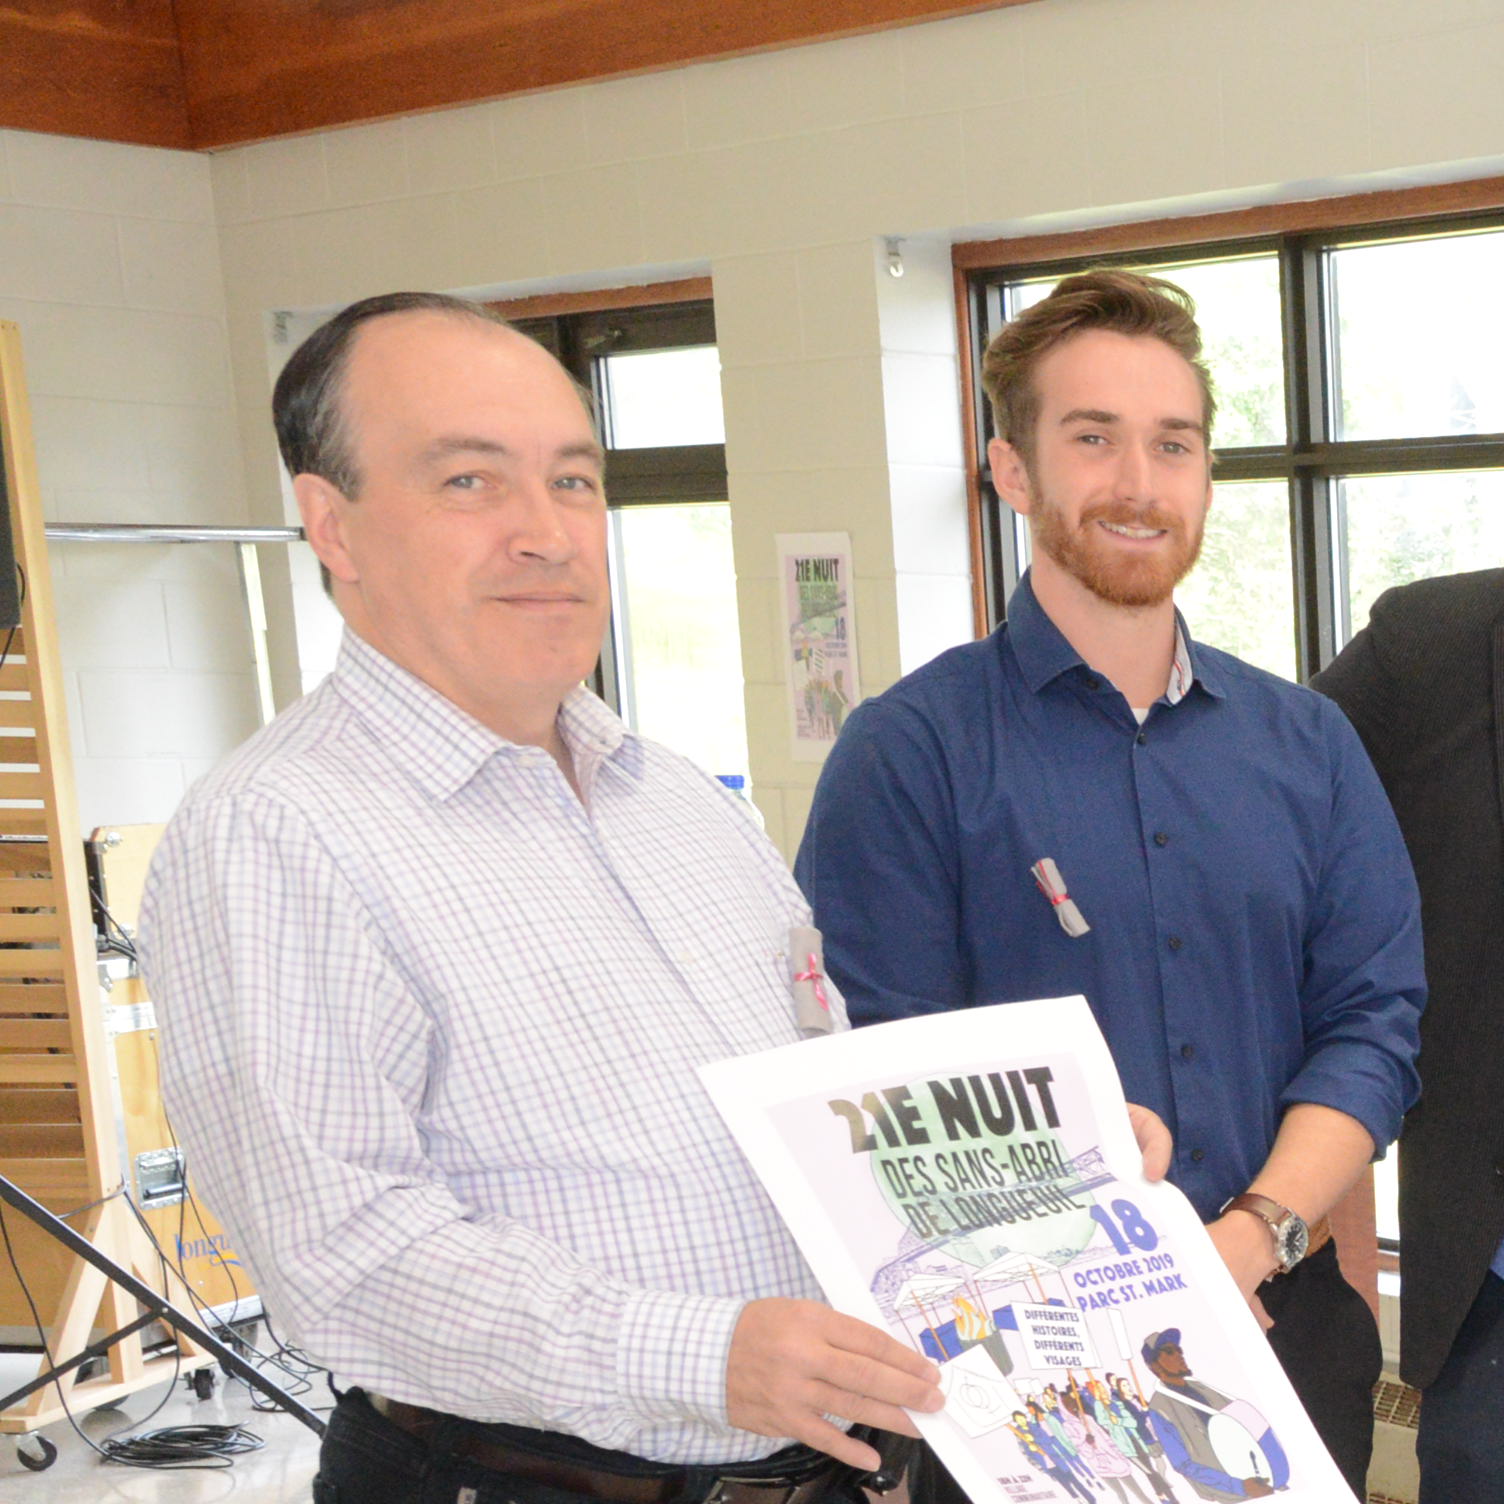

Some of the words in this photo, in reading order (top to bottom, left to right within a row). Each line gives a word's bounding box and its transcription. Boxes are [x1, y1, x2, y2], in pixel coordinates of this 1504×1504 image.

[813, 558, 839, 582] NUIT
[827, 1085, 932, 1153] 21E
[926, 1066, 1061, 1141] NUIT
[880, 1155, 938, 1199] DES
[934, 1139, 1070, 1194] SANS-ABRI
[902, 1201, 953, 1239] DE
[938, 1184, 1086, 1232] LONGUEUIL
[1089, 1199, 1159, 1256] 18
[1073, 1260, 1144, 1288] OCTOBRE
[1142, 1253, 1175, 1273] 2019
[1076, 1288, 1121, 1312] PARC
[1119, 1284, 1144, 1302] ST.
[1142, 1273, 1188, 1296] MARK
[1043, 1354, 1082, 1367] VISAGES
